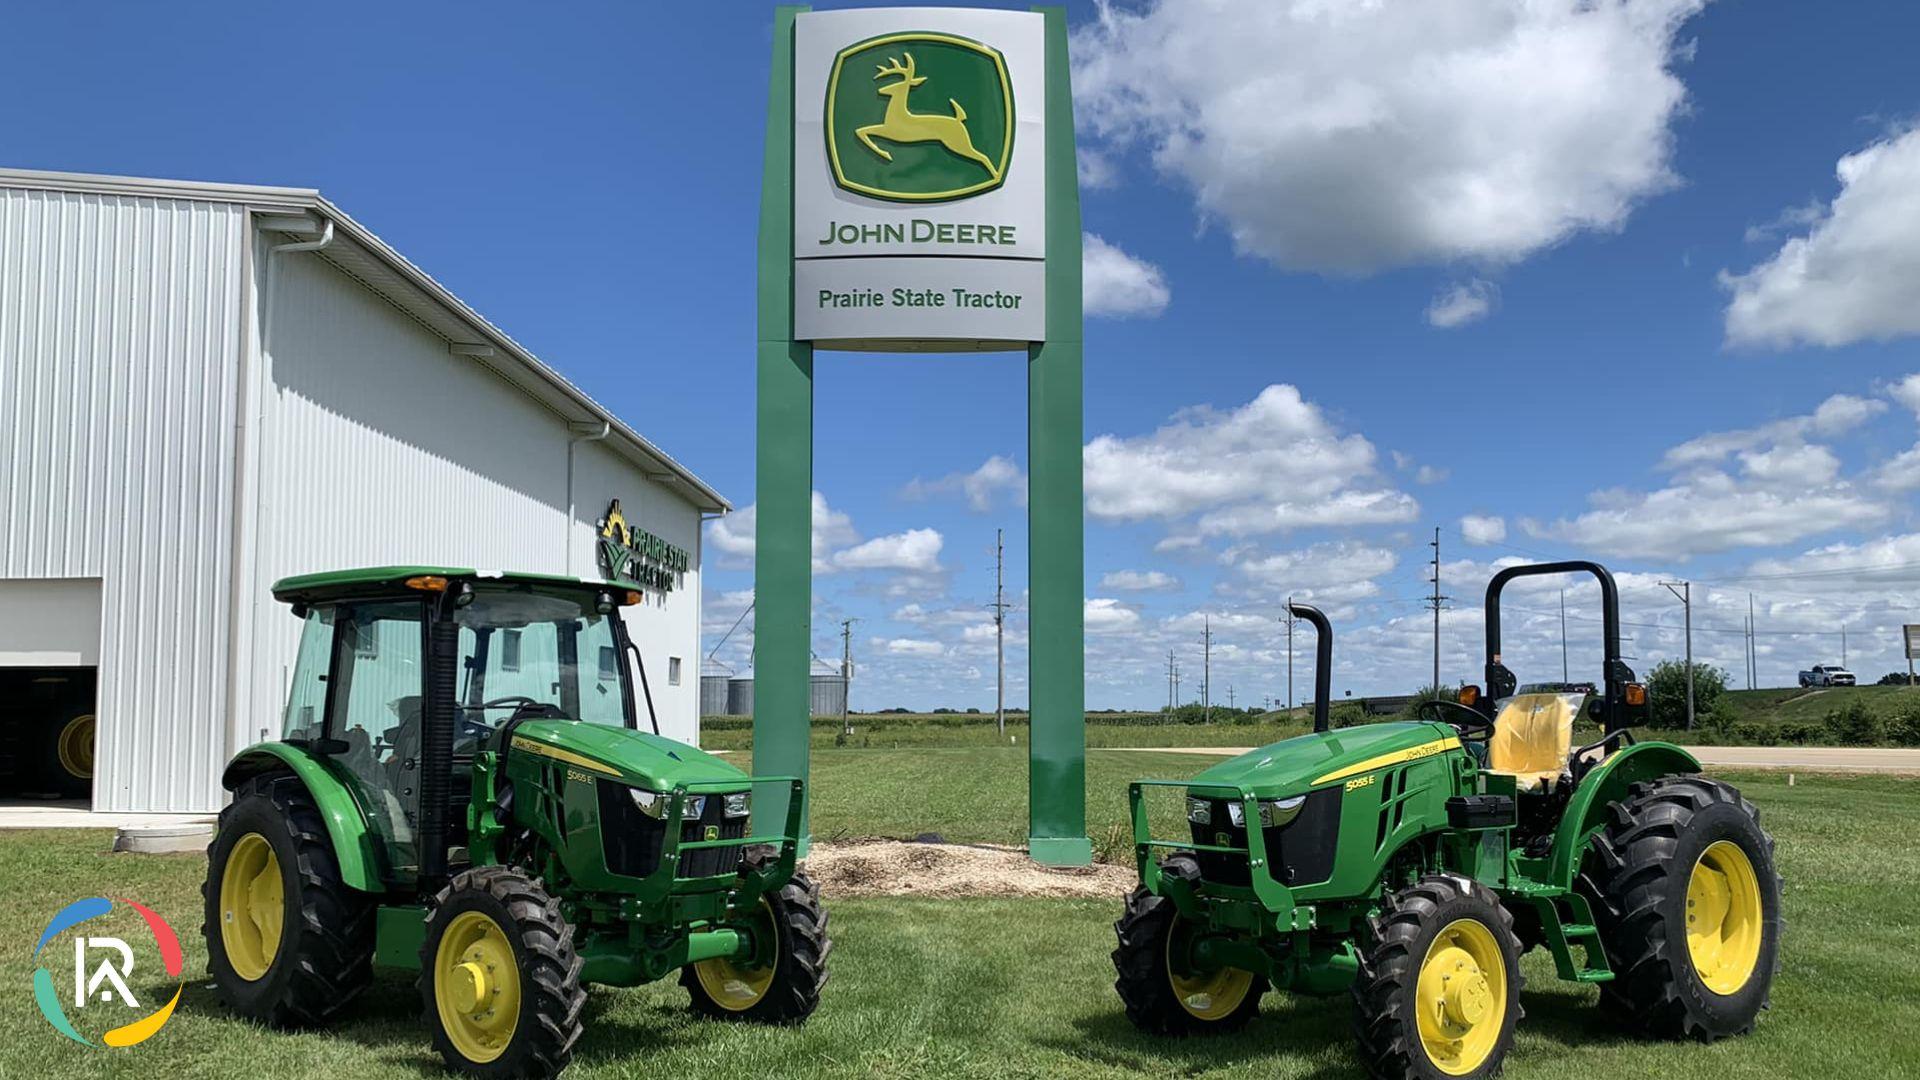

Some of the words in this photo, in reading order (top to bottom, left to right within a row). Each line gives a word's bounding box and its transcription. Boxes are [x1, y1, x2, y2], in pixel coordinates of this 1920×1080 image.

[819, 221, 905, 246] JOHN
[911, 219, 1017, 246] DEERE
[819, 288, 884, 309] Prairie
[892, 288, 945, 308] State
[952, 288, 1022, 309] Tractor
[631, 526, 668, 564] PRAIRIE
[1346, 777, 1369, 791] 5055
